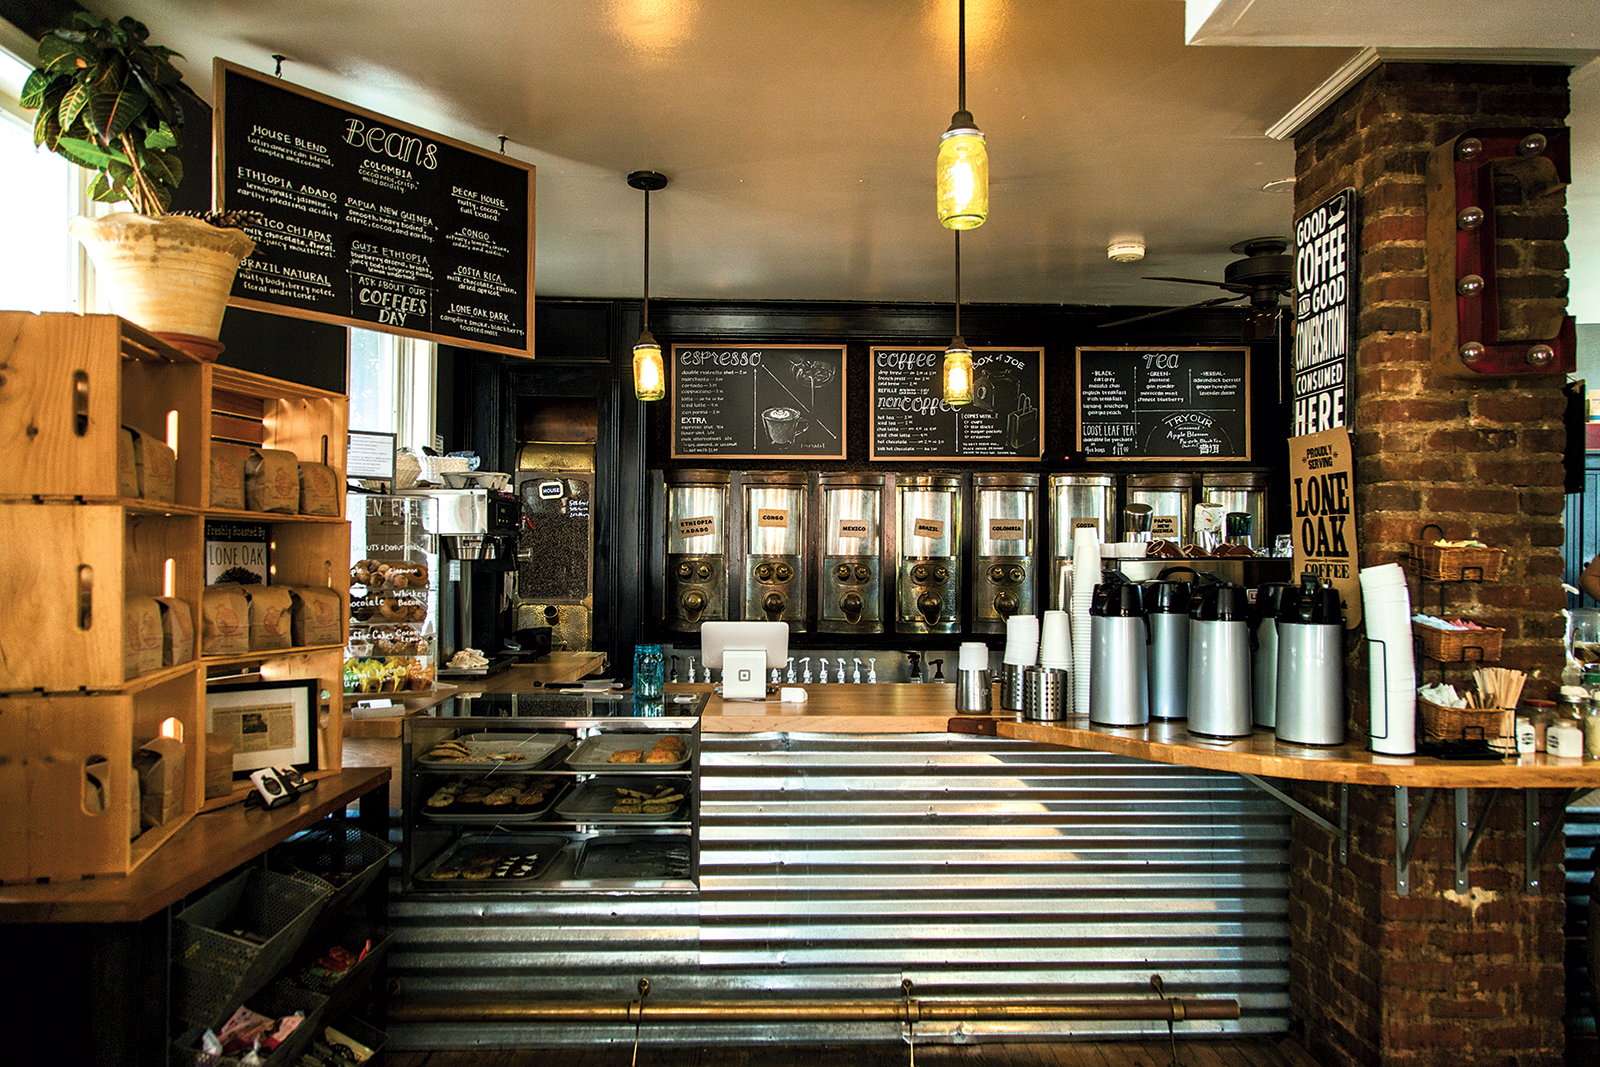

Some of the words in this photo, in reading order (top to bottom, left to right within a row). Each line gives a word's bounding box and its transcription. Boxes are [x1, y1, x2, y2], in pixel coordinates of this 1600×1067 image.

[247, 135, 270, 148] latin
[270, 144, 307, 158] american
[253, 124, 291, 144] HOUSE
[294, 137, 327, 153] BLEND
[341, 118, 438, 170] Beans
[253, 145, 285, 159] complex
[285, 155, 300, 164] and
[358, 168, 380, 179] cocoa
[363, 159, 413, 180] COLOMBIA
[237, 166, 293, 189] ETHIOPIA
[300, 184, 337, 201] ADADO
[362, 176, 378, 185] mild
[269, 196, 307, 212] pleasing
[452, 185, 478, 199] DECAF
[480, 194, 505, 208] HOUSE
[347, 197, 376, 211] PAPUA
[379, 205, 398, 216] NEW
[400, 211, 433, 226] GUINEA
[460, 206, 473, 215] full
[379, 216, 400, 228] heavy
[1297, 207, 1326, 248] GOOD
[243, 227, 263, 237] milk
[286, 224, 332, 243] CHIAPAS
[395, 228, 409, 236] and
[461, 227, 490, 241] CONGO
[266, 239, 287, 251] juicy
[351, 240, 379, 253] GUJI
[382, 247, 428, 264] ETHIOPIA
[1296, 222, 1346, 294] COFFEE
[240, 258, 281, 274] BRAZIL
[282, 267, 331, 285] NATURAL
[446, 274, 462, 283] milk
[457, 265, 481, 278] COSTA
[483, 271, 502, 283] RICA
[239, 272, 264, 285] nutty
[288, 282, 310, 294] berry
[243, 281, 267, 292] floral
[358, 276, 377, 286] ASK
[378, 280, 405, 292] ABOUT
[408, 286, 426, 297] OUR
[458, 283, 476, 292] dried
[358, 287, 428, 314] COFFEES
[1298, 297, 1311, 317] AND
[1312, 274, 1345, 313] GOOD
[378, 309, 407, 327] DAY
[450, 303, 472, 315] LONE
[472, 307, 488, 318] OAK
[488, 311, 510, 323] DARK
[459, 324, 484, 334] toasted
[1296, 303, 1346, 371] CONVERSATION
[680, 350, 762, 367] espresso
[971, 355, 993, 370] BOX
[1004, 354, 1026, 371] JOE
[1142, 353, 1180, 370] Tea
[1296, 362, 1344, 396] CONSUMED
[1164, 413, 1190, 428] TRY
[1189, 413, 1213, 428] OUR
[1295, 387, 1344, 437] HERE
[1083, 425, 1103, 436] LOOSE
[1103, 425, 1120, 436] LEAF
[1122, 425, 1135, 436] TEA
[1166, 430, 1186, 440] Apple
[1306, 444, 1333, 459] PROUDLY
[1307, 456, 1333, 470] SERVING
[1294, 471, 1350, 518] LONE
[680, 519, 713, 527] ETHIOPIA
[207, 525, 231, 539] Freshly
[232, 525, 257, 536] Roasted
[258, 526, 266, 540] By
[1301, 515, 1350, 557] OAK
[1304, 563, 1350, 579] COFFEE
[349, 596, 385, 607] ocolate
[392, 589, 427, 601] Whiskey
[349, 630, 371, 641] offee
[372, 630, 394, 640] Cakes
[343, 670, 370, 680] aramel
